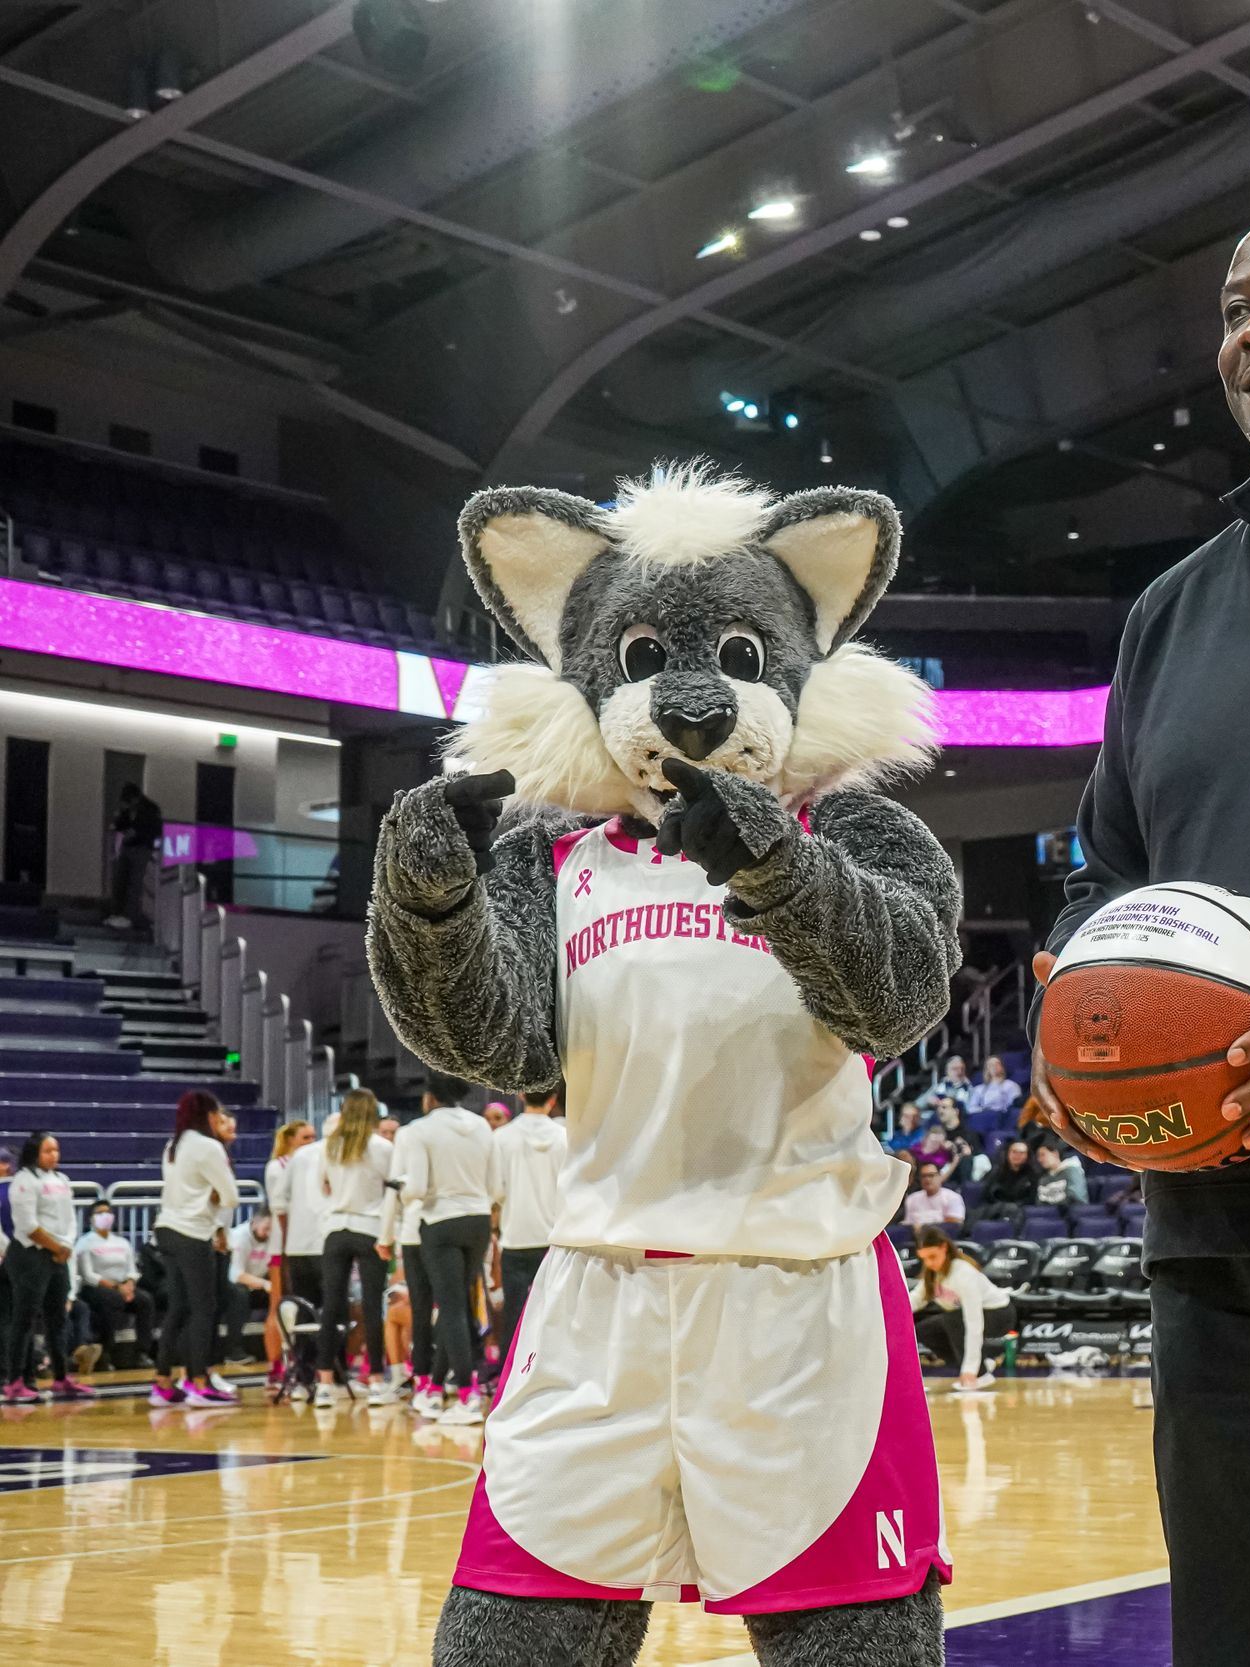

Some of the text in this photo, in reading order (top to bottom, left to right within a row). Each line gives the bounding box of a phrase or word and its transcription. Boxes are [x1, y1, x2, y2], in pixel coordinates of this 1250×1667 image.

[1115, 913, 1160, 924] WOMEN'S
[1159, 916, 1220, 946] BASKETBALL
[1120, 923, 1144, 932] MONTH
[1143, 925, 1177, 939] HONOREE
[876, 1510, 907, 1569] N
